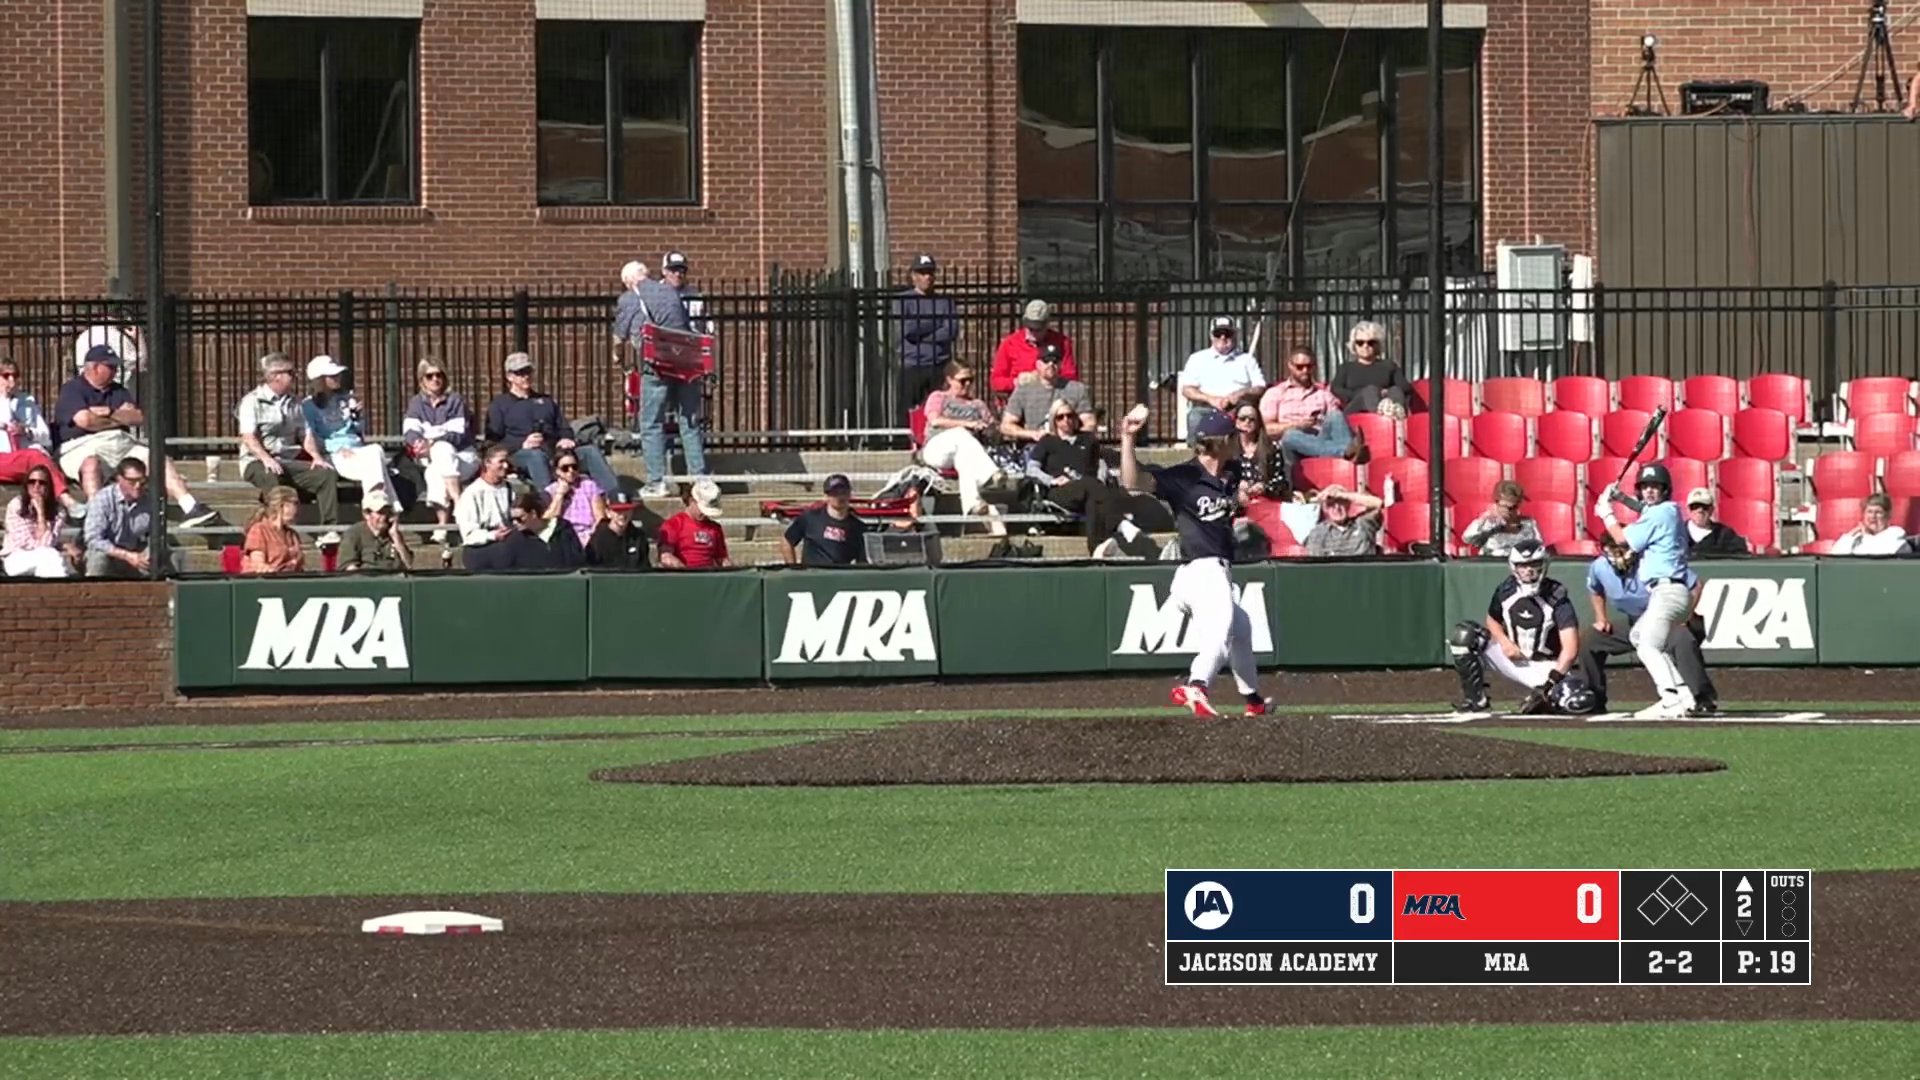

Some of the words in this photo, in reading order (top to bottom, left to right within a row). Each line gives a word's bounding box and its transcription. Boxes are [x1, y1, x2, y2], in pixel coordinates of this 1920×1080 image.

[239, 595, 409, 670] MRA
[772, 589, 937, 664] MRA
[1111, 581, 1274, 654] MA
